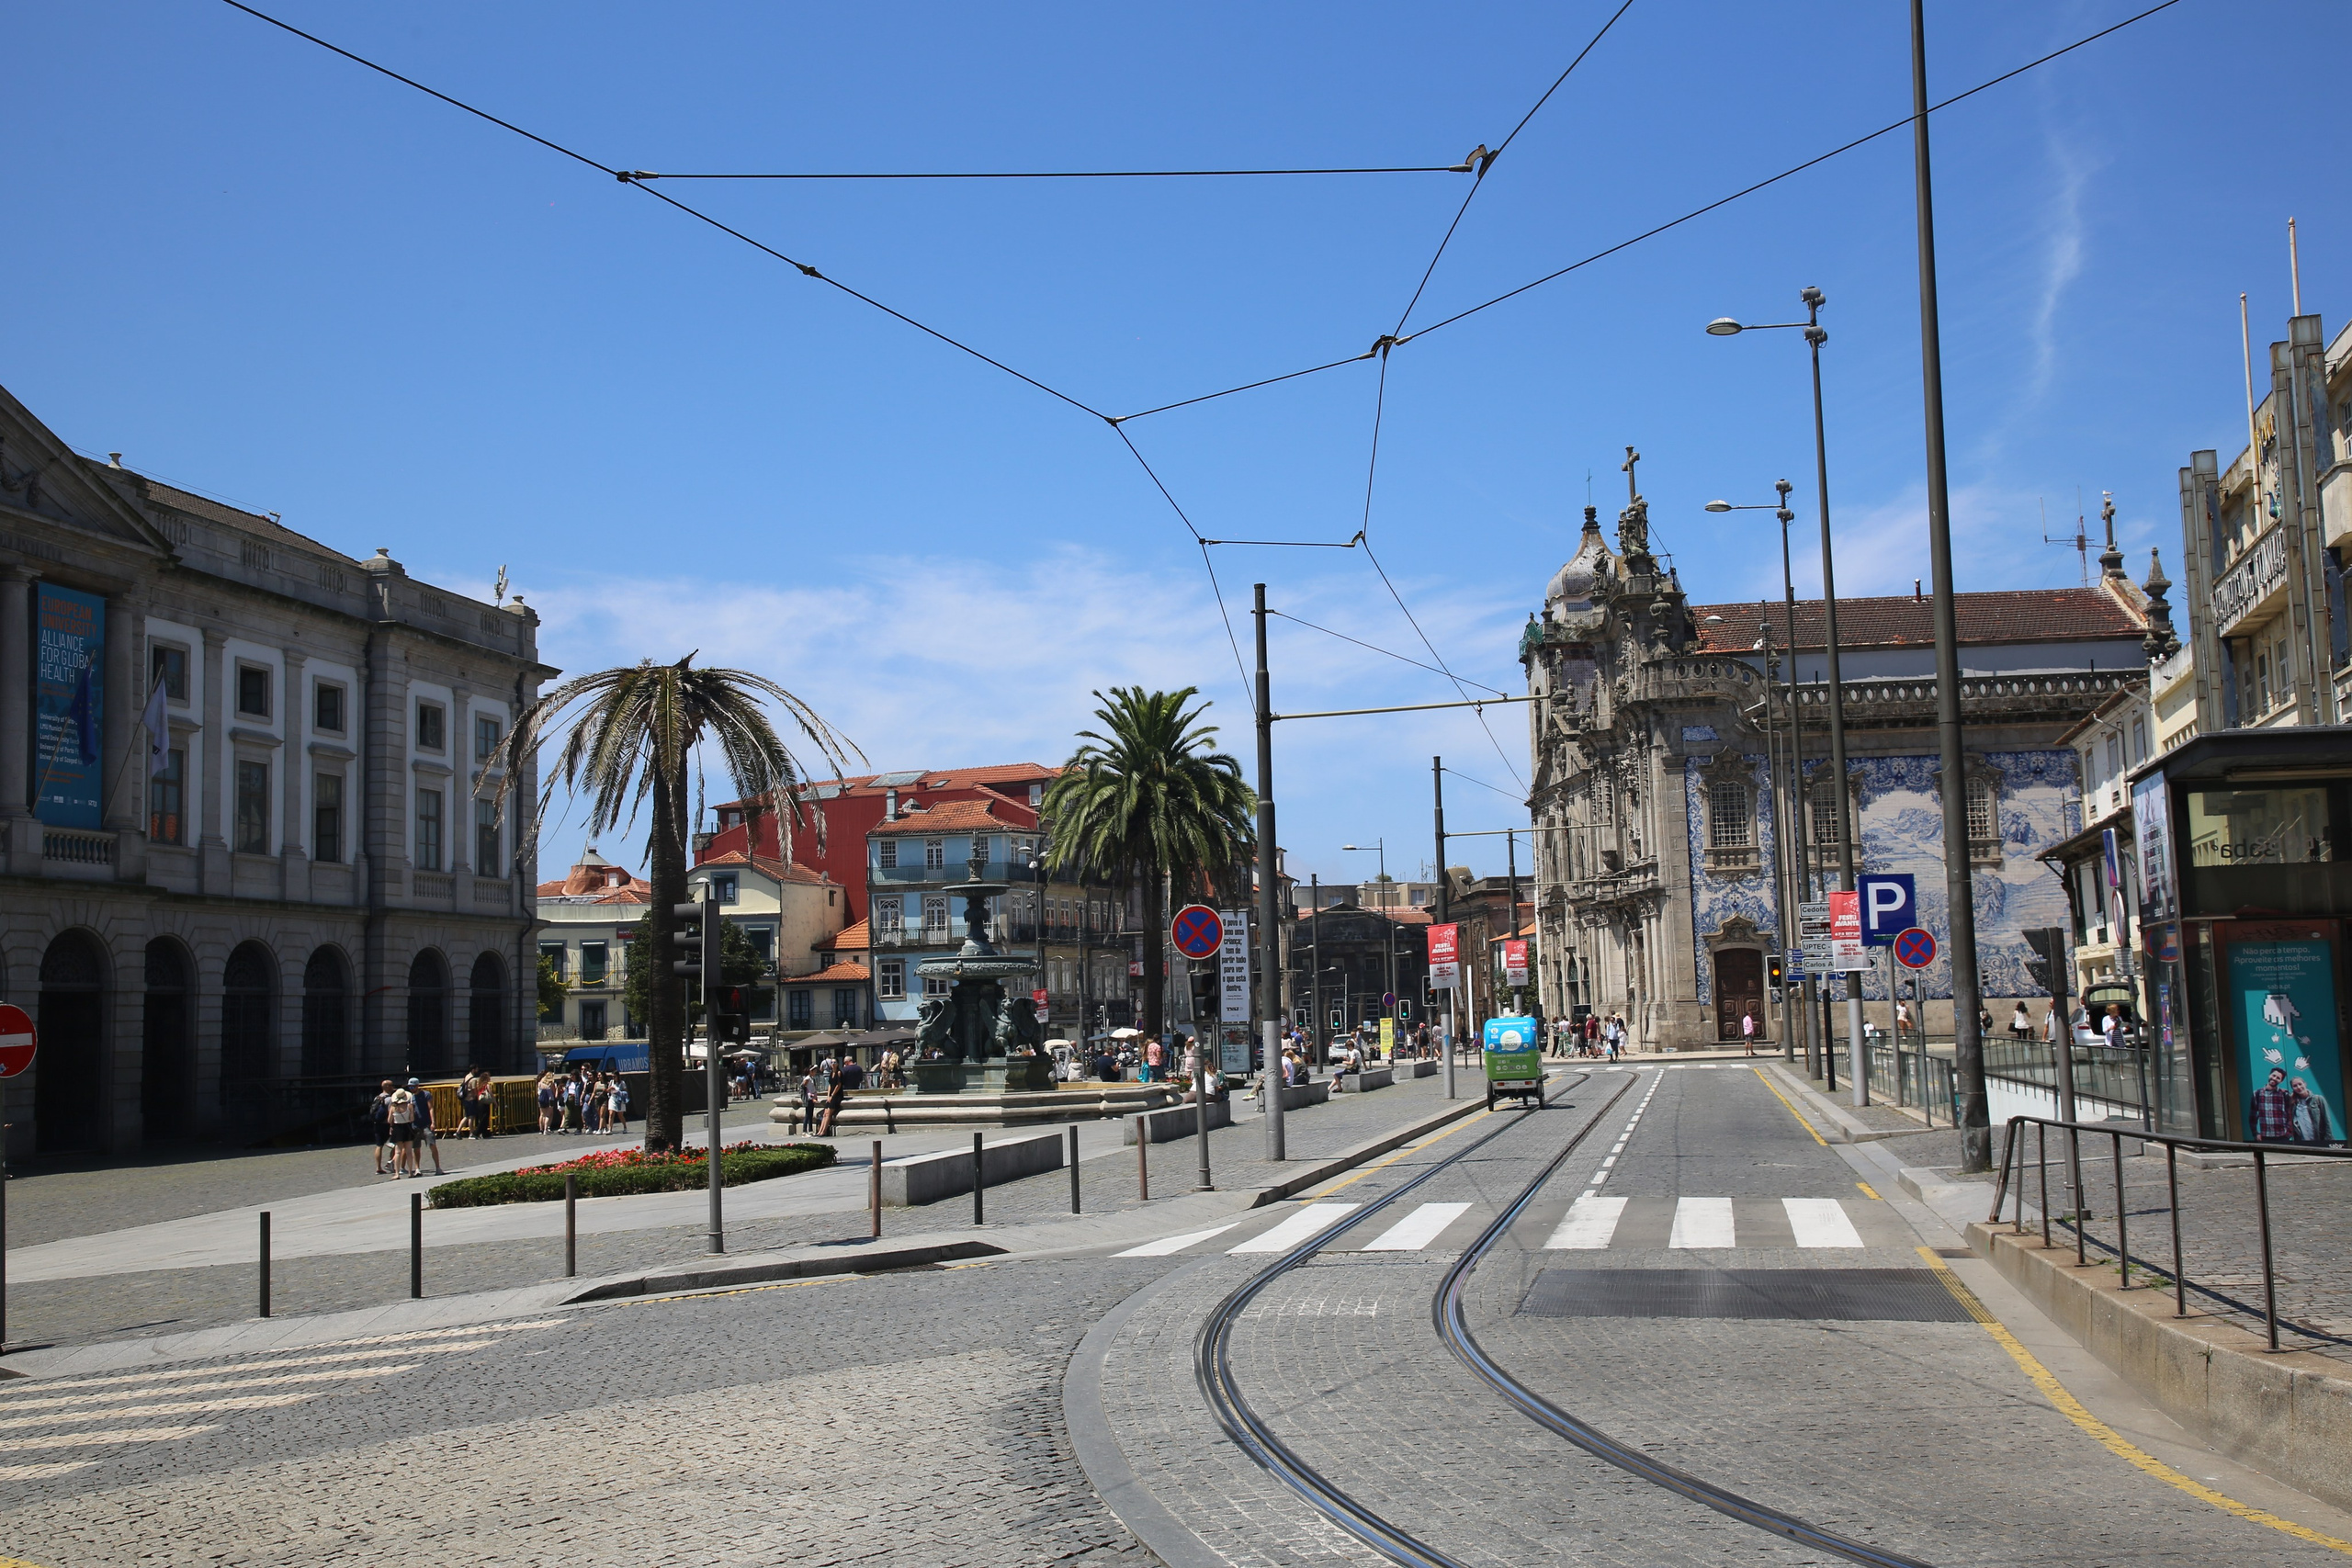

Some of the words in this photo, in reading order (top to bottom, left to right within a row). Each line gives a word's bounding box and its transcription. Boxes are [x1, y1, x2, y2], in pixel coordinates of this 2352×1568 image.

[41, 595, 93, 621] EUROPEAN
[41, 613, 96, 638] UNIVERSITY
[41, 629, 85, 653] ALLIANCE
[41, 646, 60, 664] FOR
[40, 662, 75, 683] HEALTH
[40, 713, 60, 723] University
[1868, 882, 1905, 930] P
[1227, 919, 1238, 928] povo
[2243, 947, 2258, 955] Não
[2283, 946, 2311, 954] tempo.
[1222, 956, 1235, 964] partir
[2234, 956, 2272, 964] Aproveite
[2256, 963, 2300, 972] momentos!
[618, 1057, 649, 1071] URBANOS
